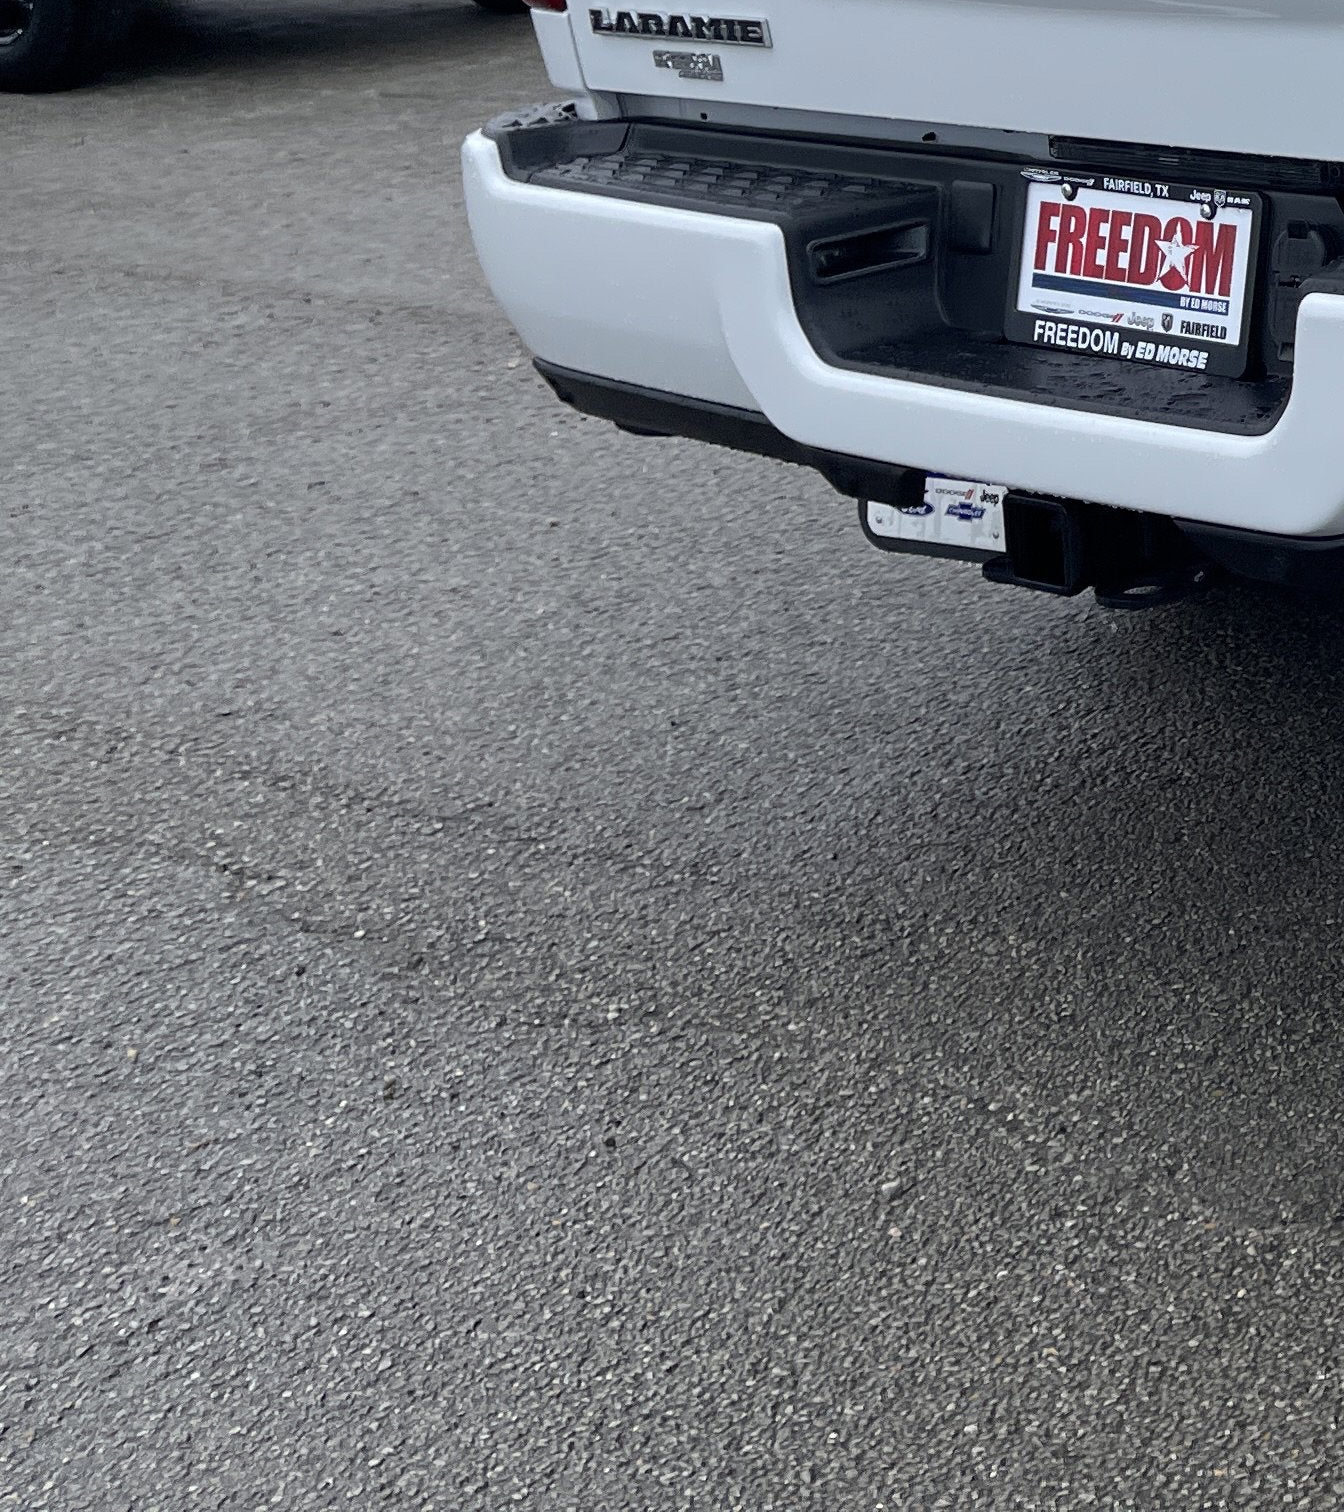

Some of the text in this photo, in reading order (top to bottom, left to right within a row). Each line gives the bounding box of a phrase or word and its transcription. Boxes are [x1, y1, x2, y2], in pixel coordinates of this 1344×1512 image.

[588, 7, 774, 49] LARAMIE
[1155, 185, 1169, 198] TX
[1189, 189, 1212, 204] Jeep
[1033, 200, 1238, 298] FREEDOM
[1179, 295, 1228, 314] BY ED MORSE
[1127, 311, 1155, 329] Jeep
[1180, 320, 1228, 340] FAIRFIELD
[1033, 319, 1120, 355] FREEDOM
[1135, 341, 1155, 361] ED
[1156, 345, 1210, 370] MORSE
